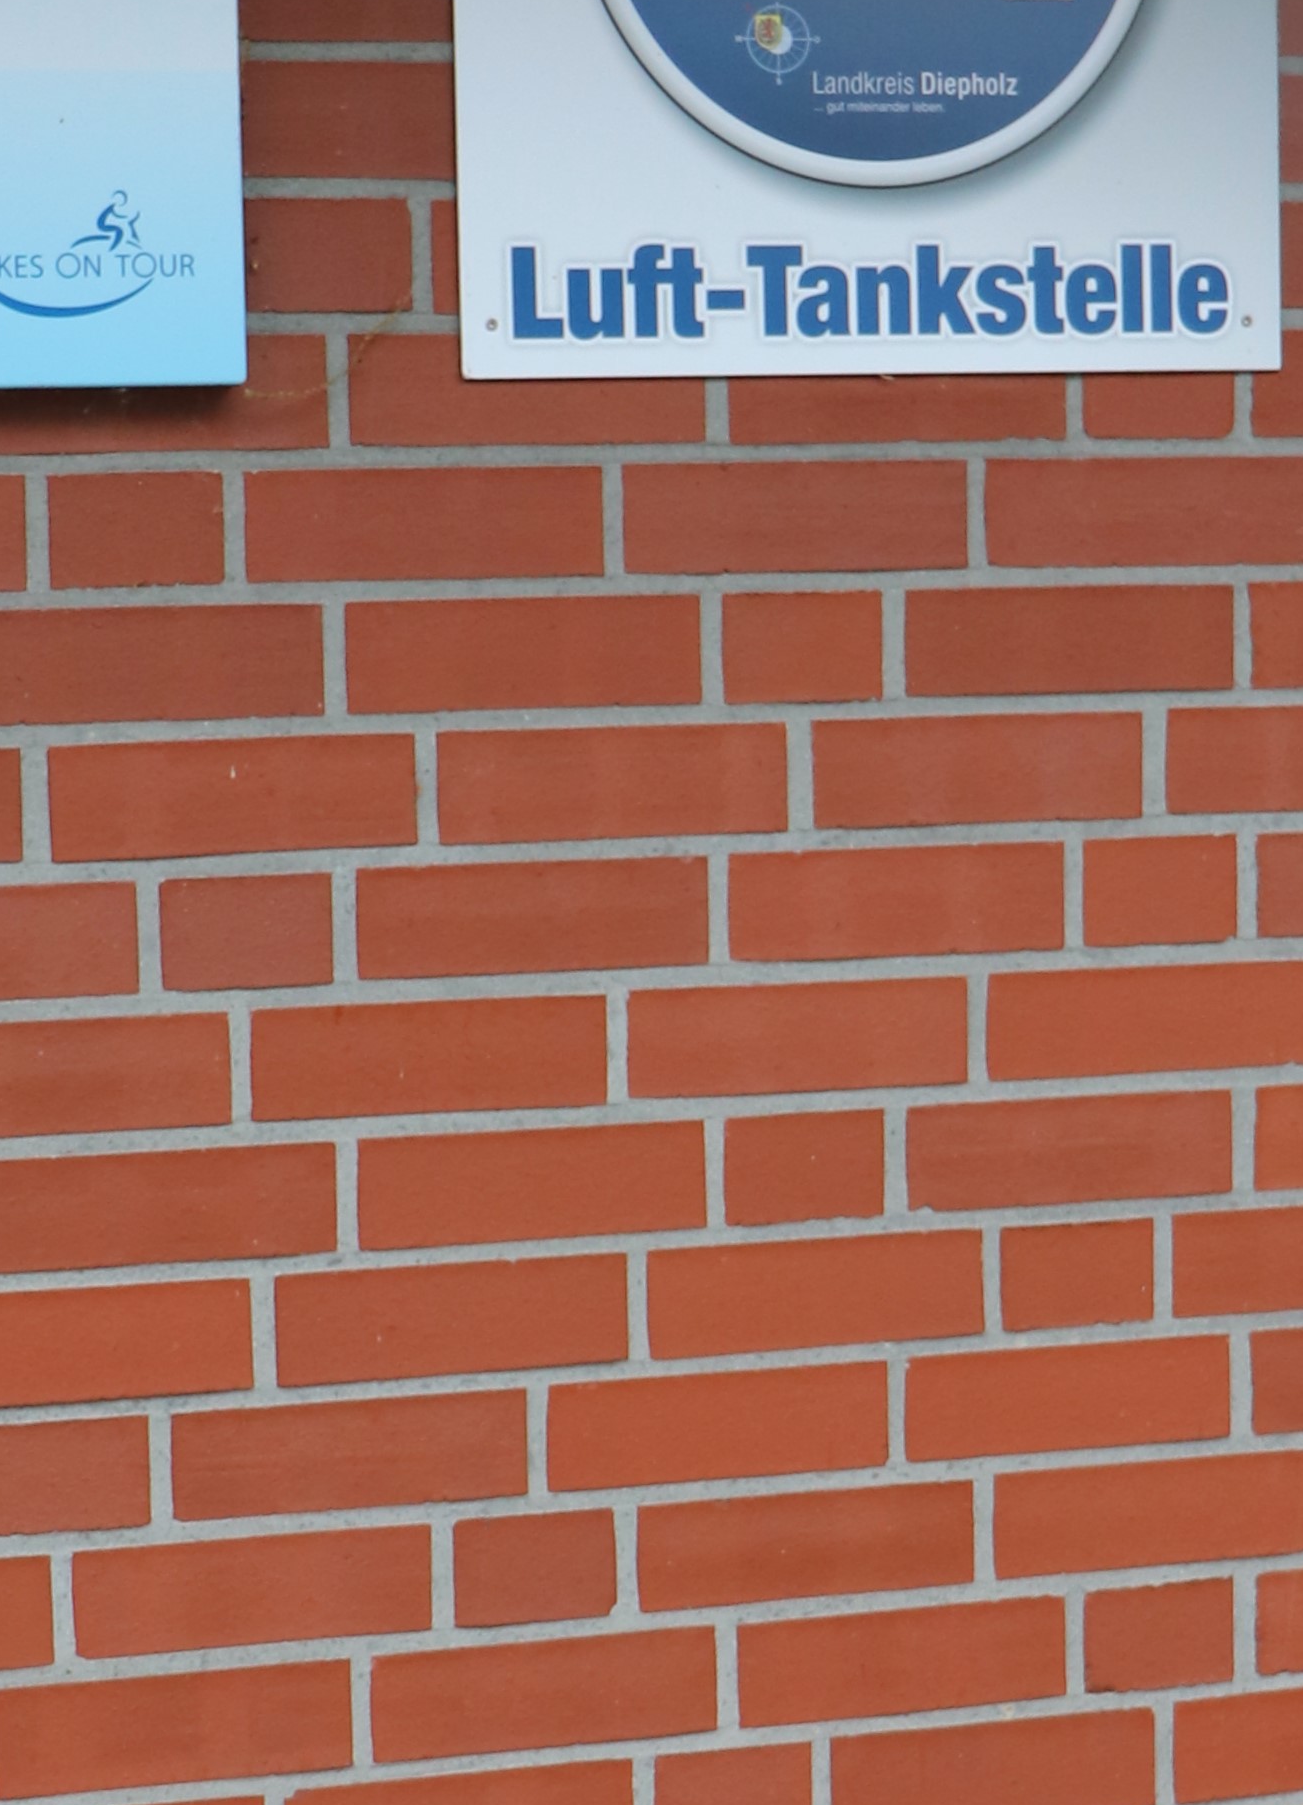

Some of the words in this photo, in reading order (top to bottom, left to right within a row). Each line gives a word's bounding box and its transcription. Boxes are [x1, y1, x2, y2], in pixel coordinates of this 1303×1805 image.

[812, 70, 915, 96] Landkreis
[920, 71, 1018, 101] Diepholz
[55, 252, 102, 280] ON
[115, 251, 196, 280] TOUR
[509, 242, 1230, 340] Luft-Tankstelle
